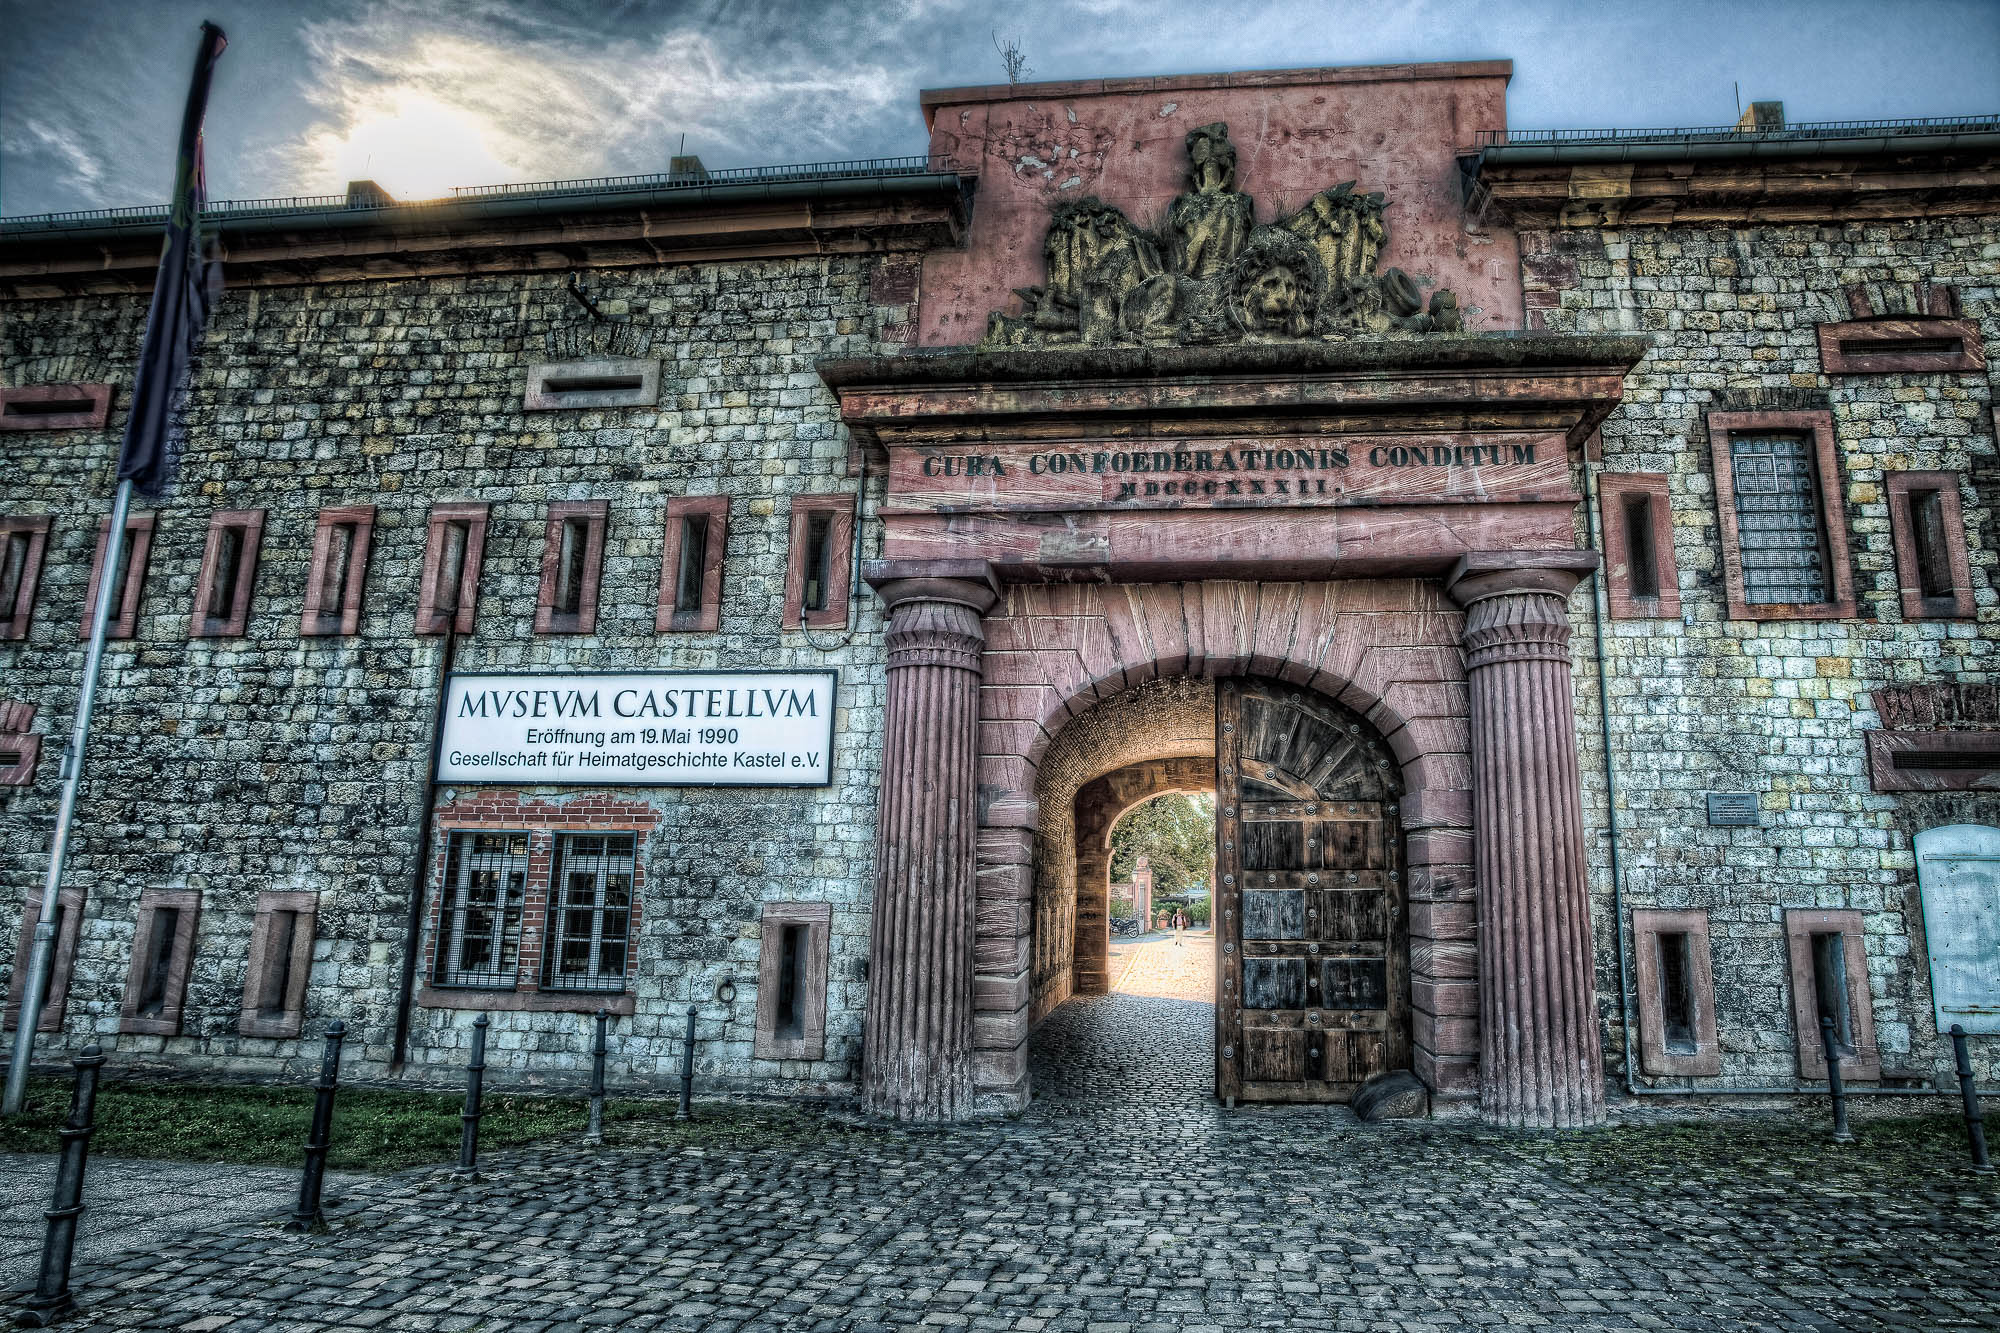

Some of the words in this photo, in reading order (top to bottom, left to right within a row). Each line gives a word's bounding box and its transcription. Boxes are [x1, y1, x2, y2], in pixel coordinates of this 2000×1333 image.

[924, 454, 1006, 477] CURA
[1030, 449, 1350, 475] CONFOEDERATIONIS
[1369, 444, 1537, 468] CONDITUM
[457, 689, 602, 718] MVSEVM
[613, 688, 819, 718] CASTELLVM
[526, 728, 605, 748] Eröffnung
[610, 731, 635, 744] am
[697, 728, 739, 744] 1990
[449, 750, 548, 766] Gesellschaft
[552, 751, 574, 767] für
[578, 751, 728, 771] Heimatgeschichte
[733, 751, 786, 768] Kastel
[791, 751, 820, 768] e.V.
